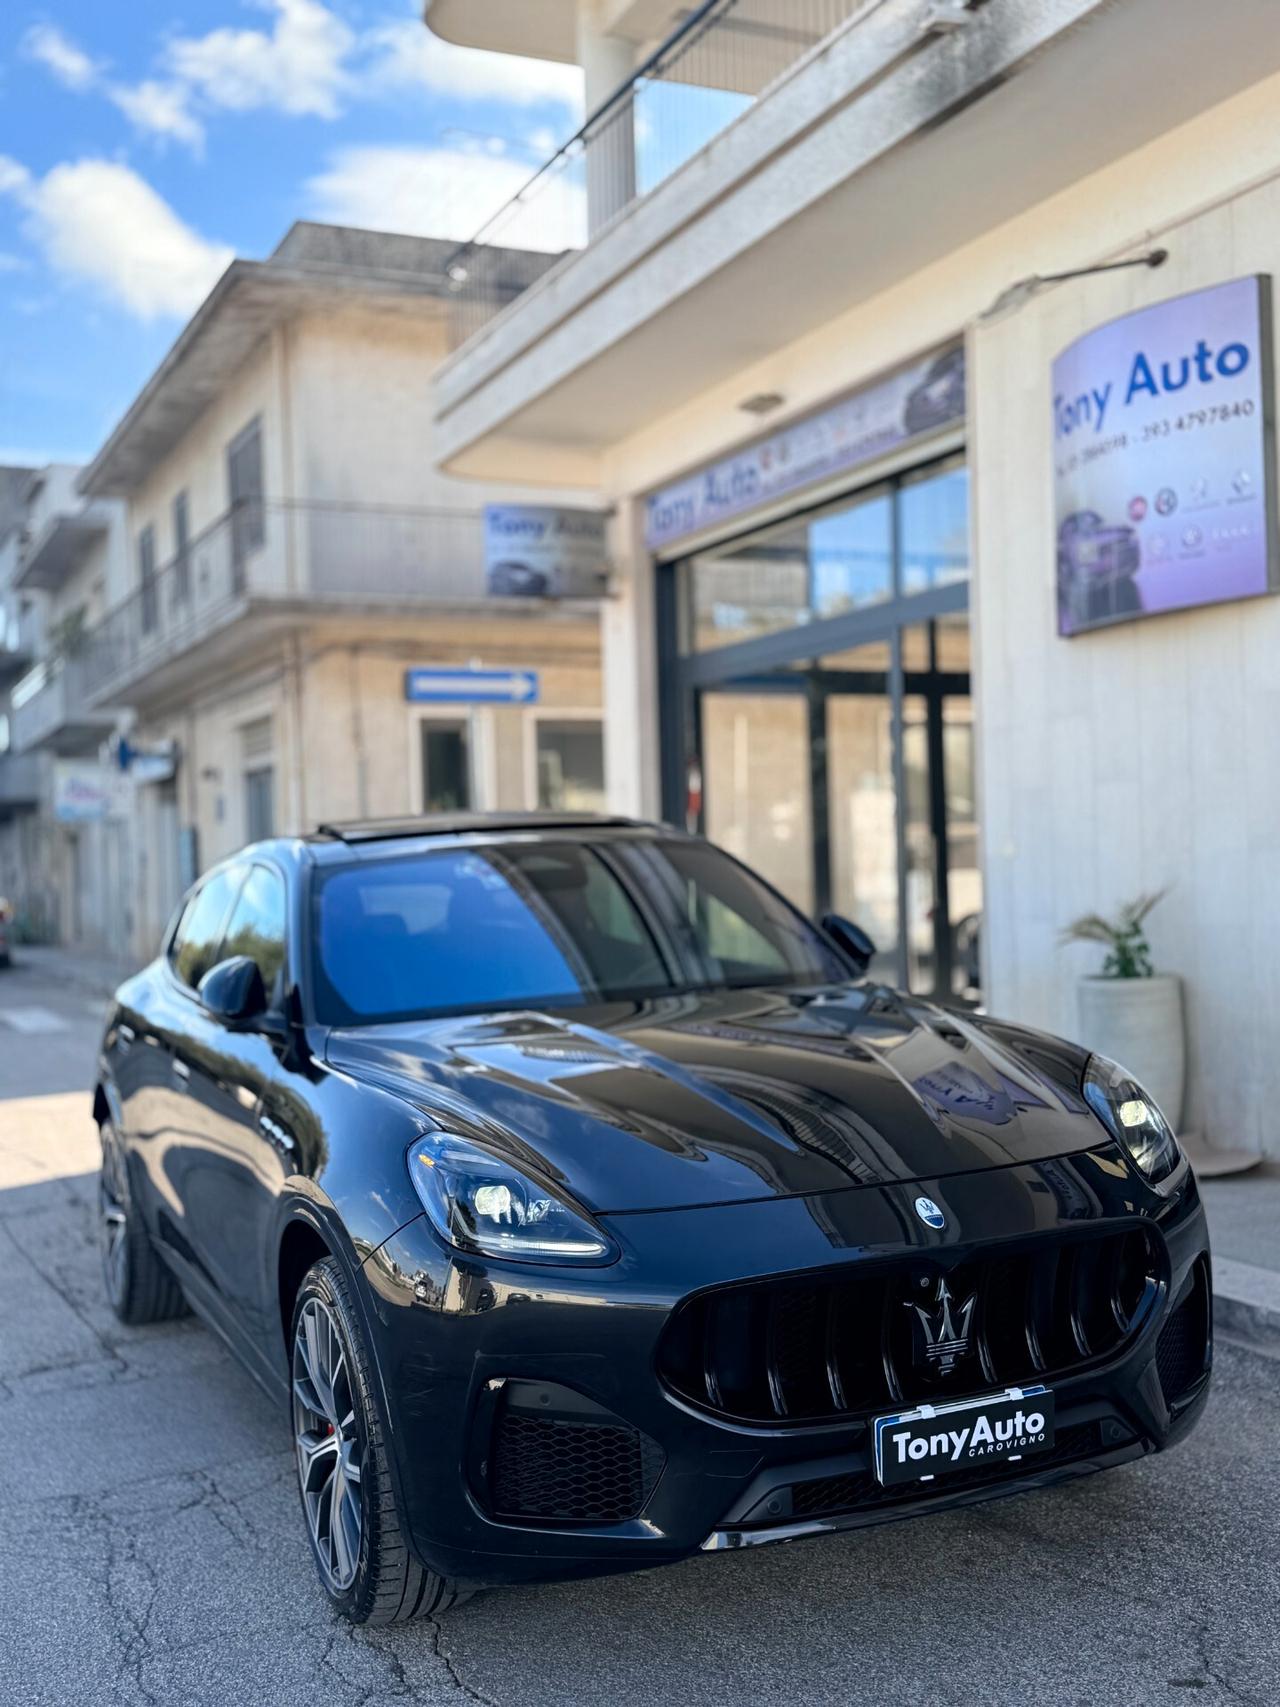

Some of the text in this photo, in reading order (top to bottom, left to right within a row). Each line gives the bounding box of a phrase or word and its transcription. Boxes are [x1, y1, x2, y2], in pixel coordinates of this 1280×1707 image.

[1124, 340, 1250, 405] Auto
[892, 1410, 1046, 1463] TonyAuto
[968, 1433, 1046, 1458] CAROVIGNO
